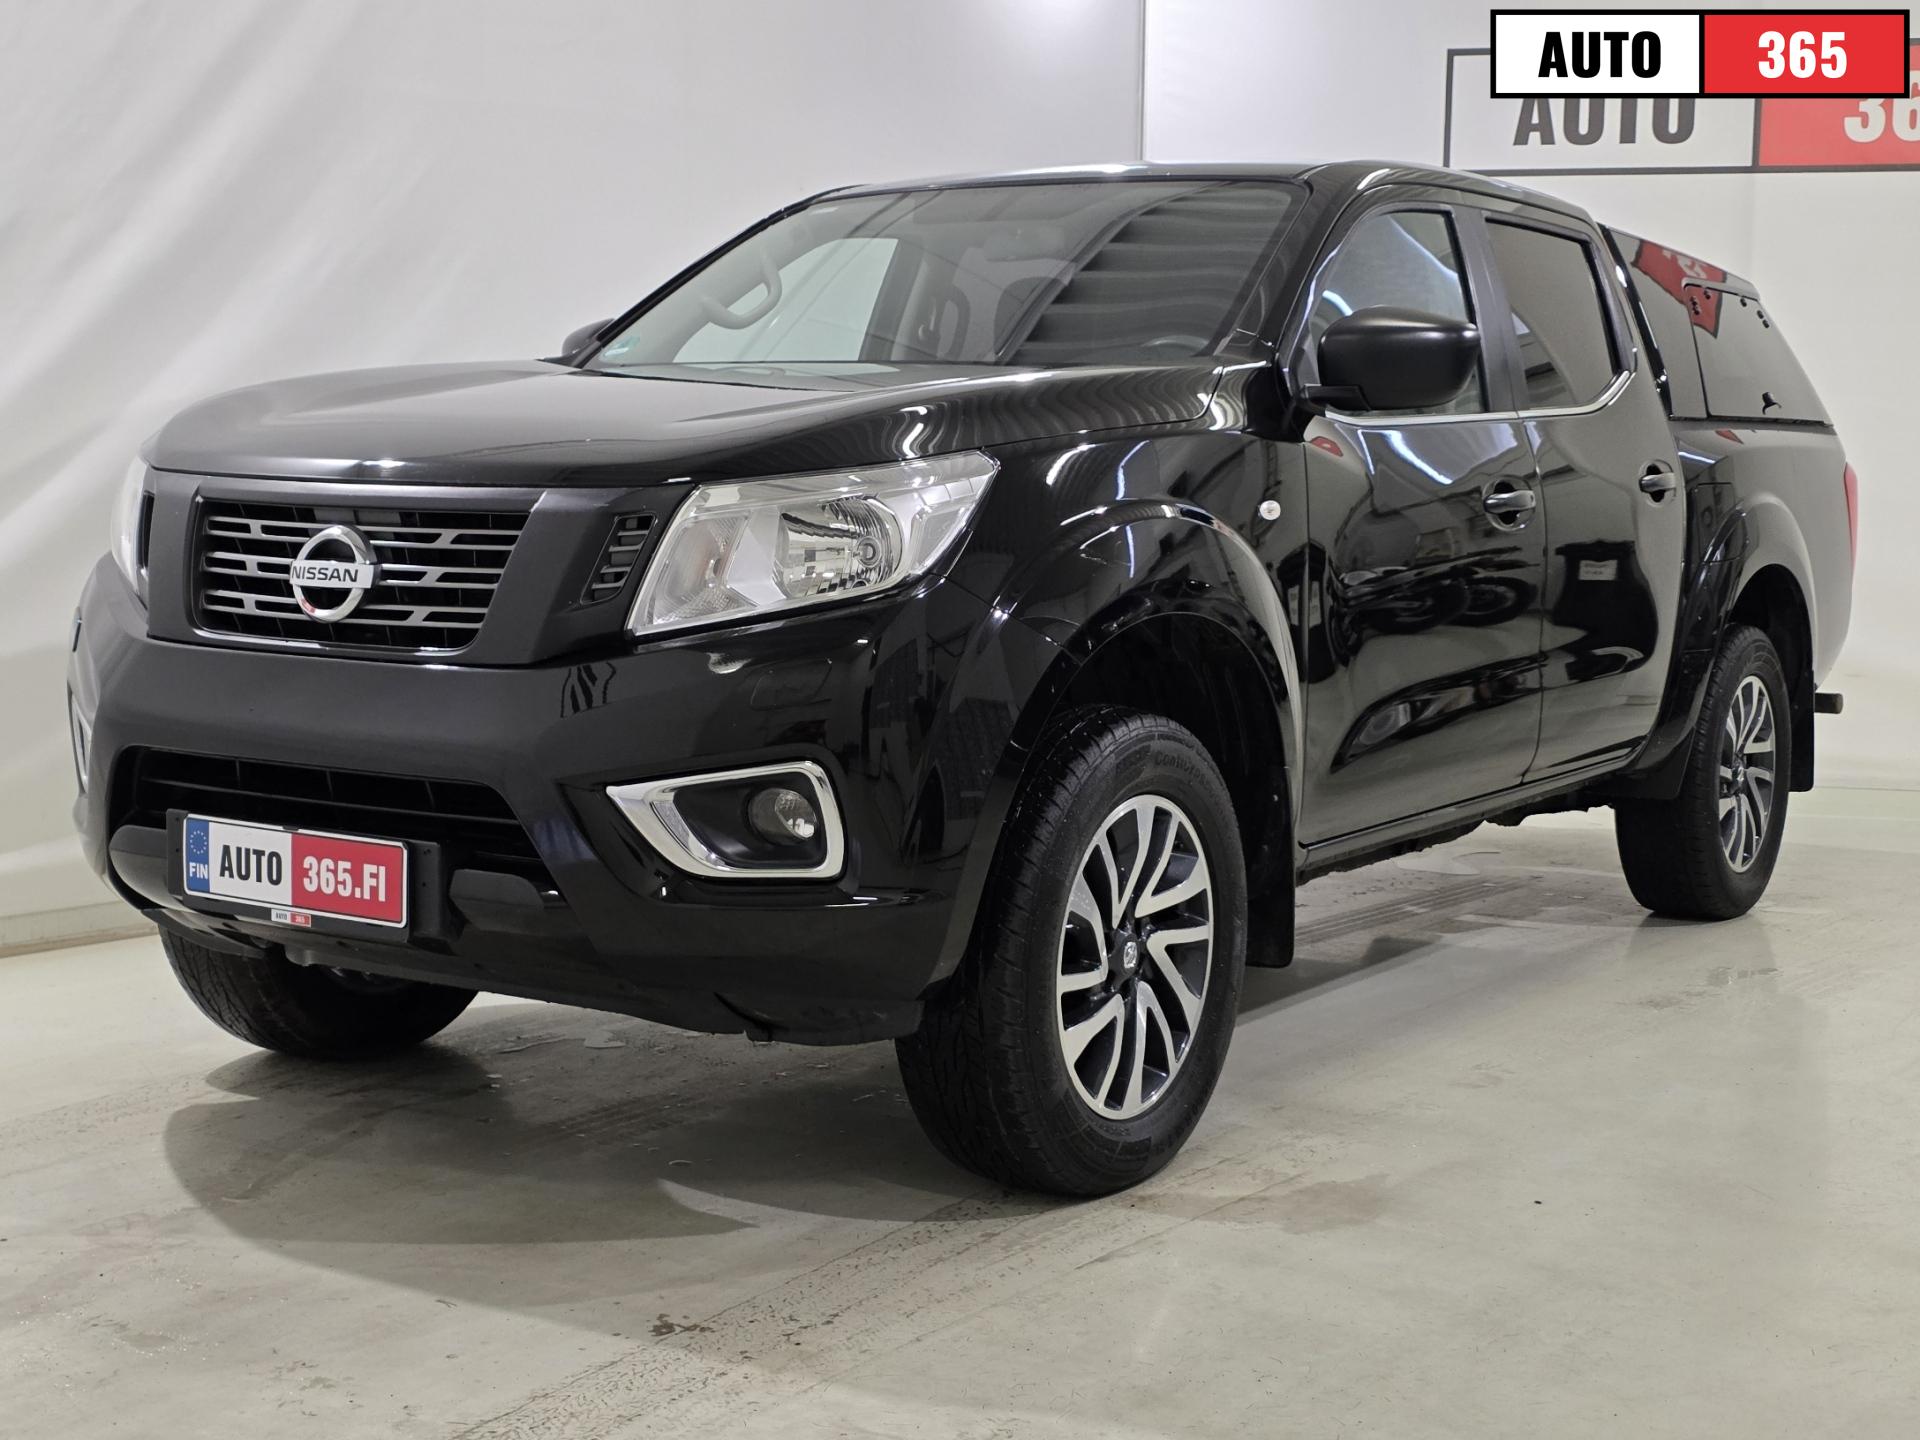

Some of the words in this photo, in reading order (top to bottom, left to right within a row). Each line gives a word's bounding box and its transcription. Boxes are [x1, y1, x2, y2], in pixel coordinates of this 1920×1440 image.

[291, 566, 358, 583] NISSAN
[189, 862, 208, 880] FIN
[219, 844, 283, 886] AUTO
[303, 856, 386, 902] 365.FI
